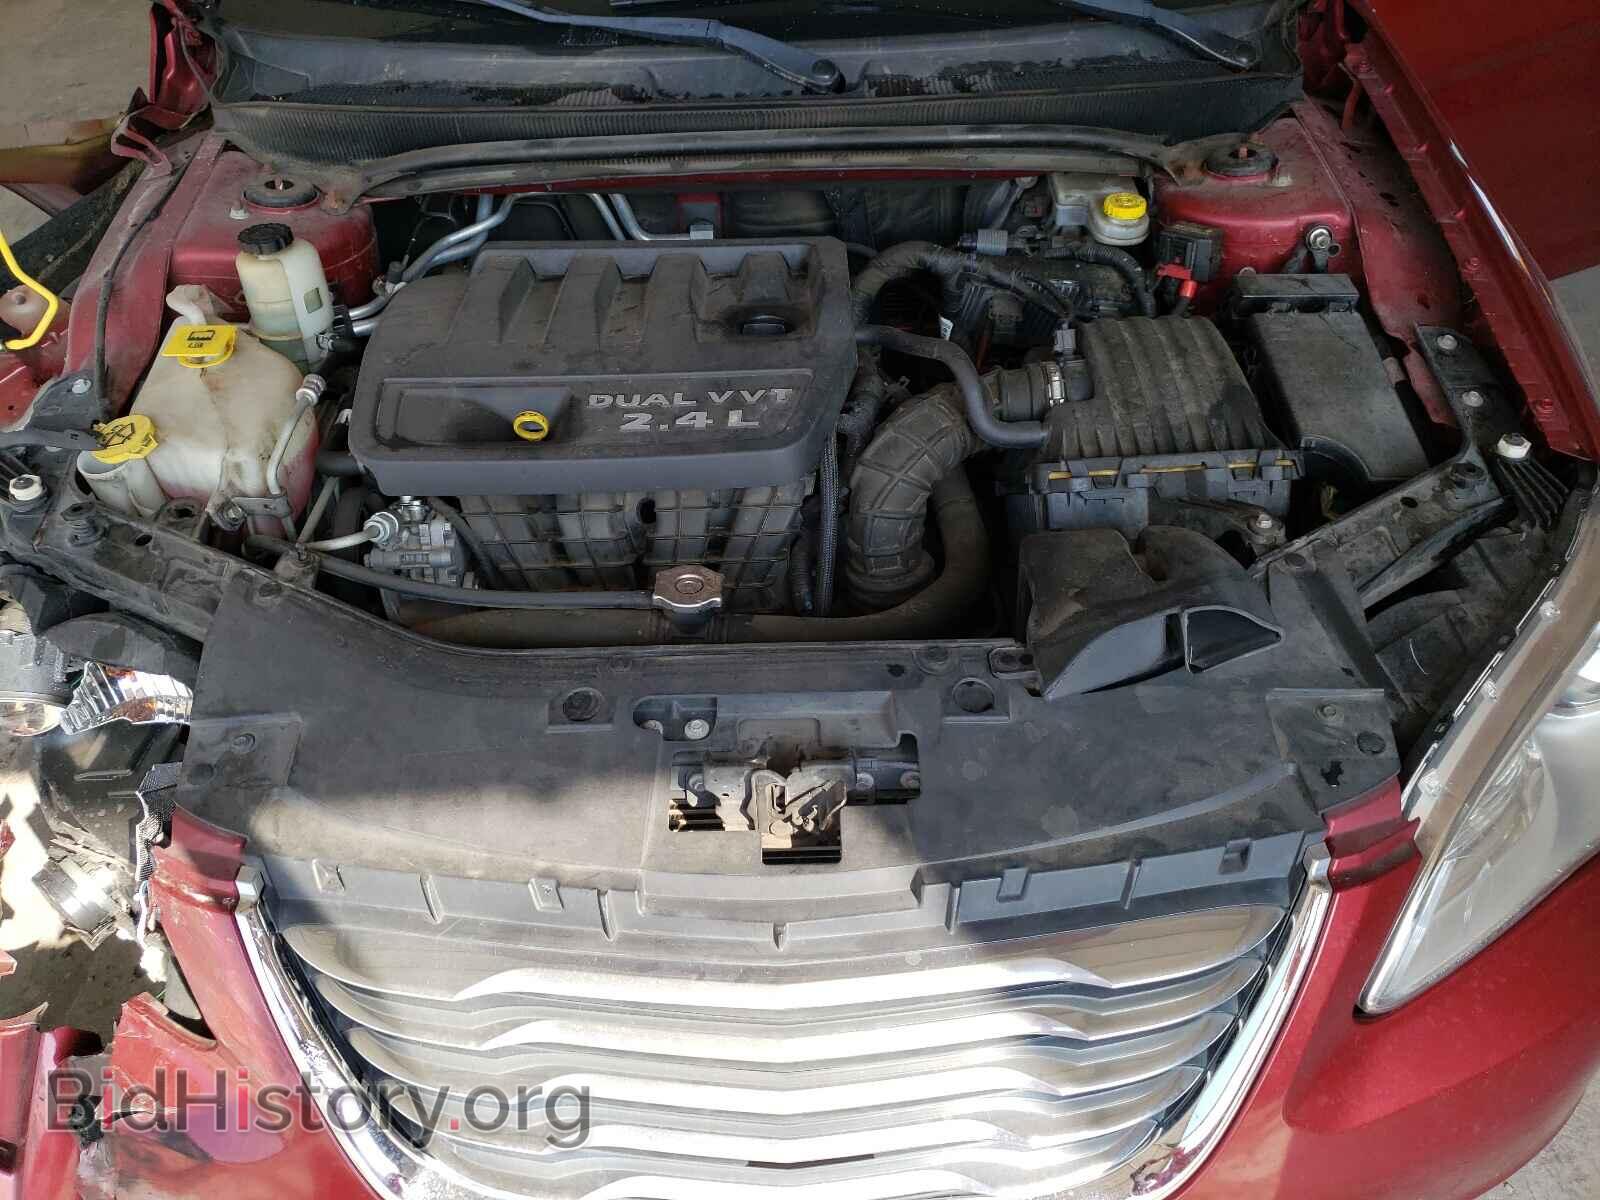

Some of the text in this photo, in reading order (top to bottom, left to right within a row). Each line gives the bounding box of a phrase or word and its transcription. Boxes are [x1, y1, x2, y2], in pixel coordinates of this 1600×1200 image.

[588, 388, 793, 408] DUAL VVT
[621, 411, 713, 431] 2.4
